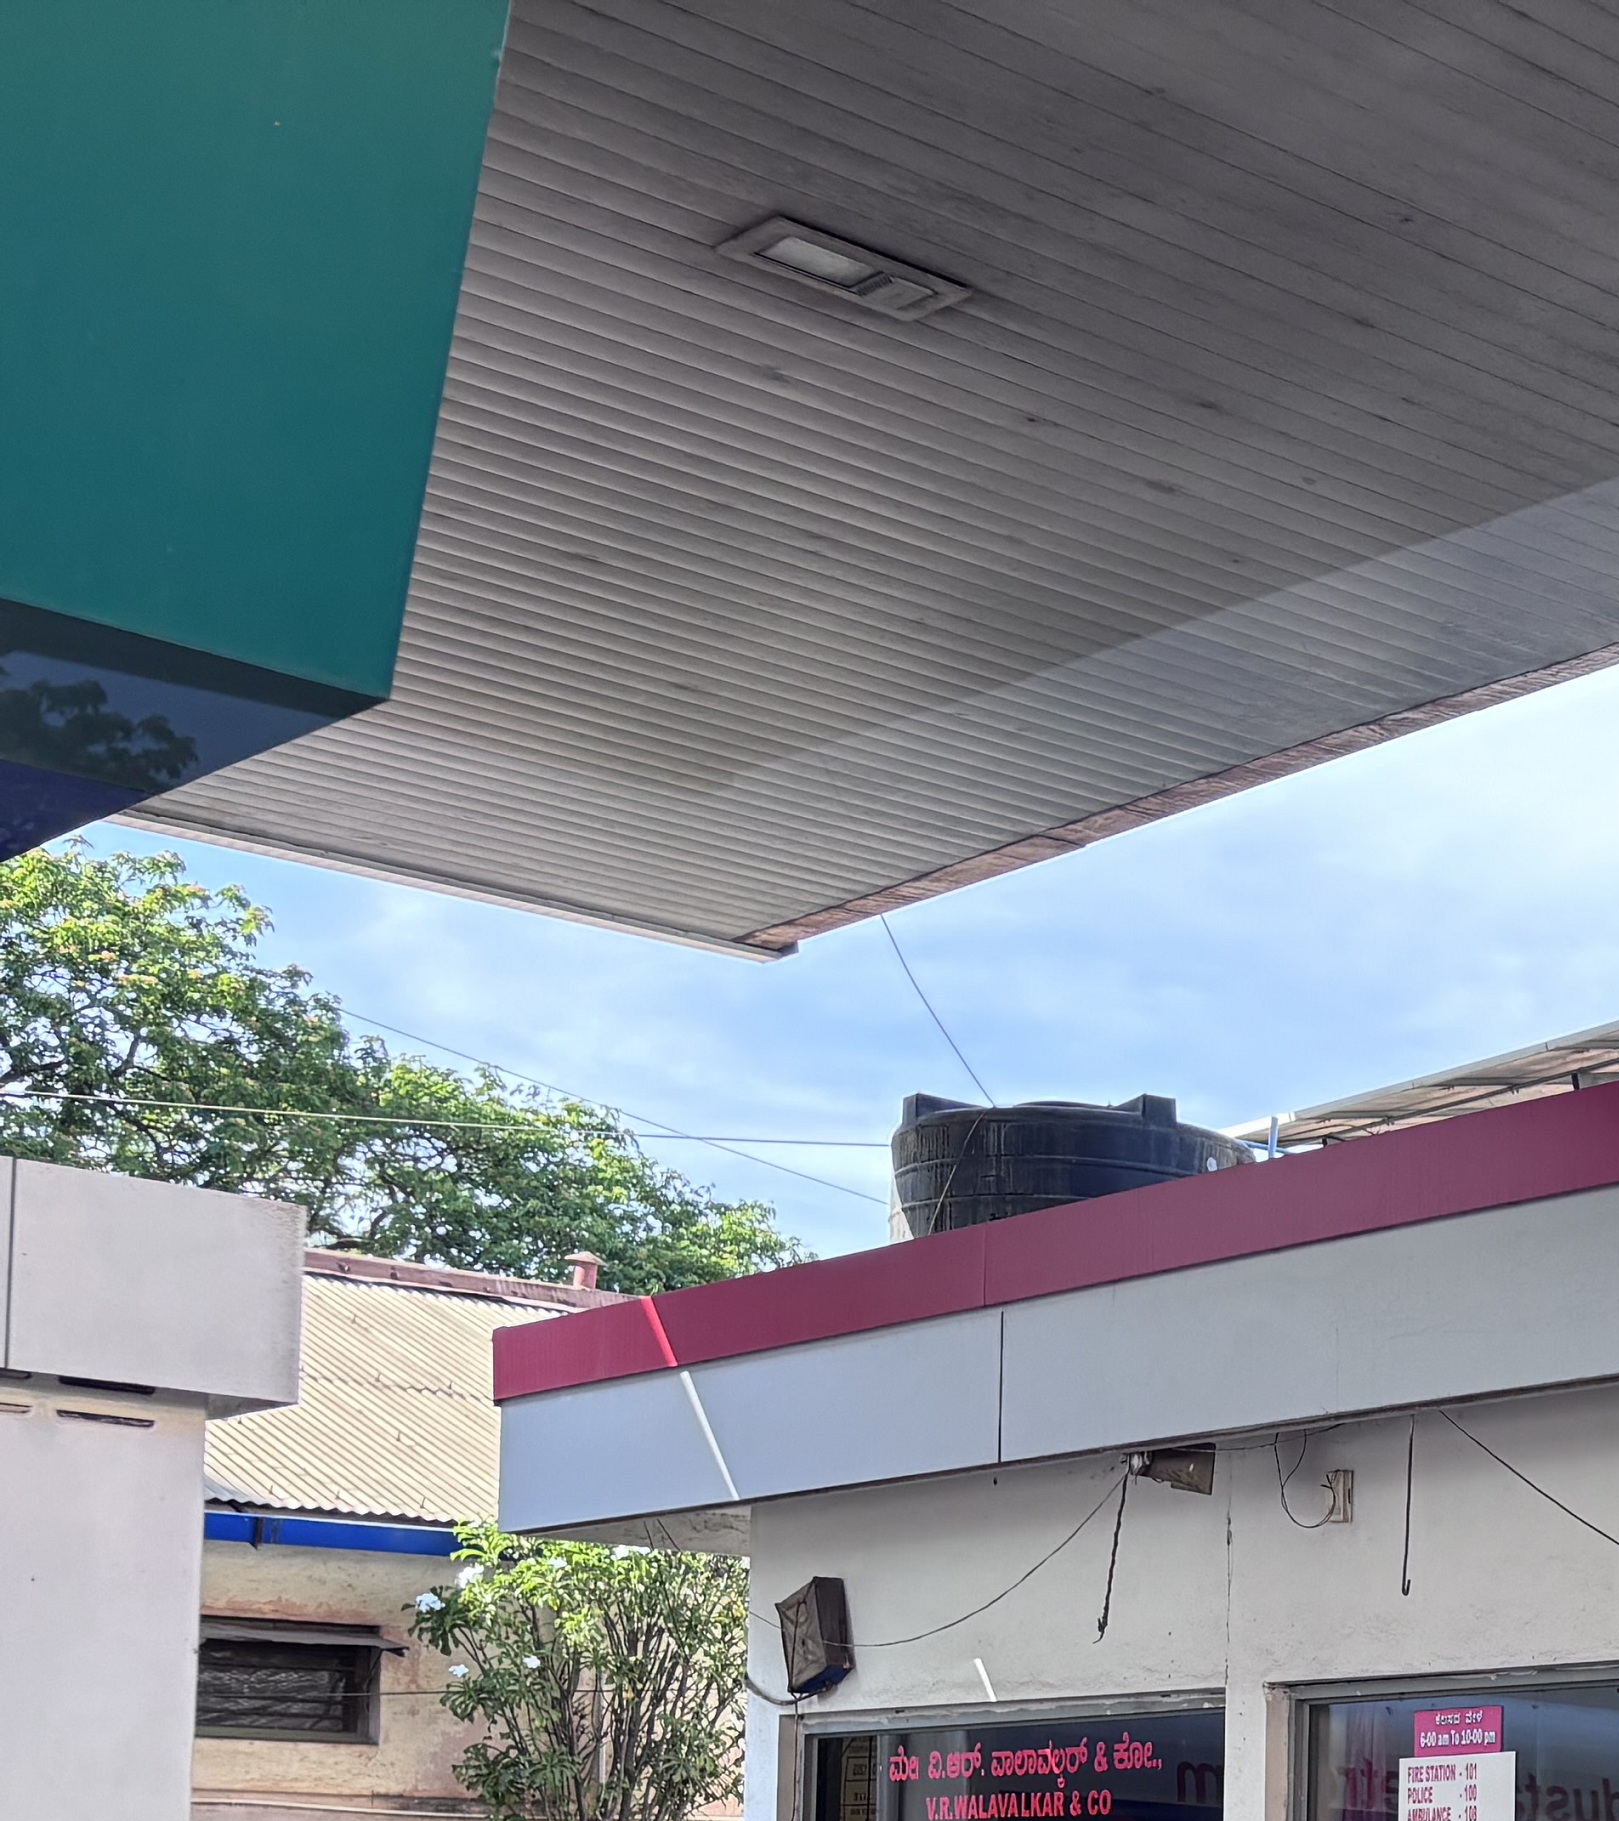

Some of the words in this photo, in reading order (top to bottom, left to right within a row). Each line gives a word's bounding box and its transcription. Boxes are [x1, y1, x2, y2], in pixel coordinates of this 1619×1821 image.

[1438, 1733, 1450, 1746] am
[1451, 1730, 1460, 1745] To
[1484, 1730, 1496, 1747] pm
[1094, 1741, 1108, 1772] &
[1408, 1766, 1424, 1783] FIRE
[1426, 1764, 1456, 1782] STATION
[1465, 1763, 1477, 1780] 101
[1070, 1794, 1082, 1816] &
[1087, 1790, 1112, 1816] CO
[1408, 1786, 1433, 1804] POLICE
[1465, 1784, 1477, 1801] 100
